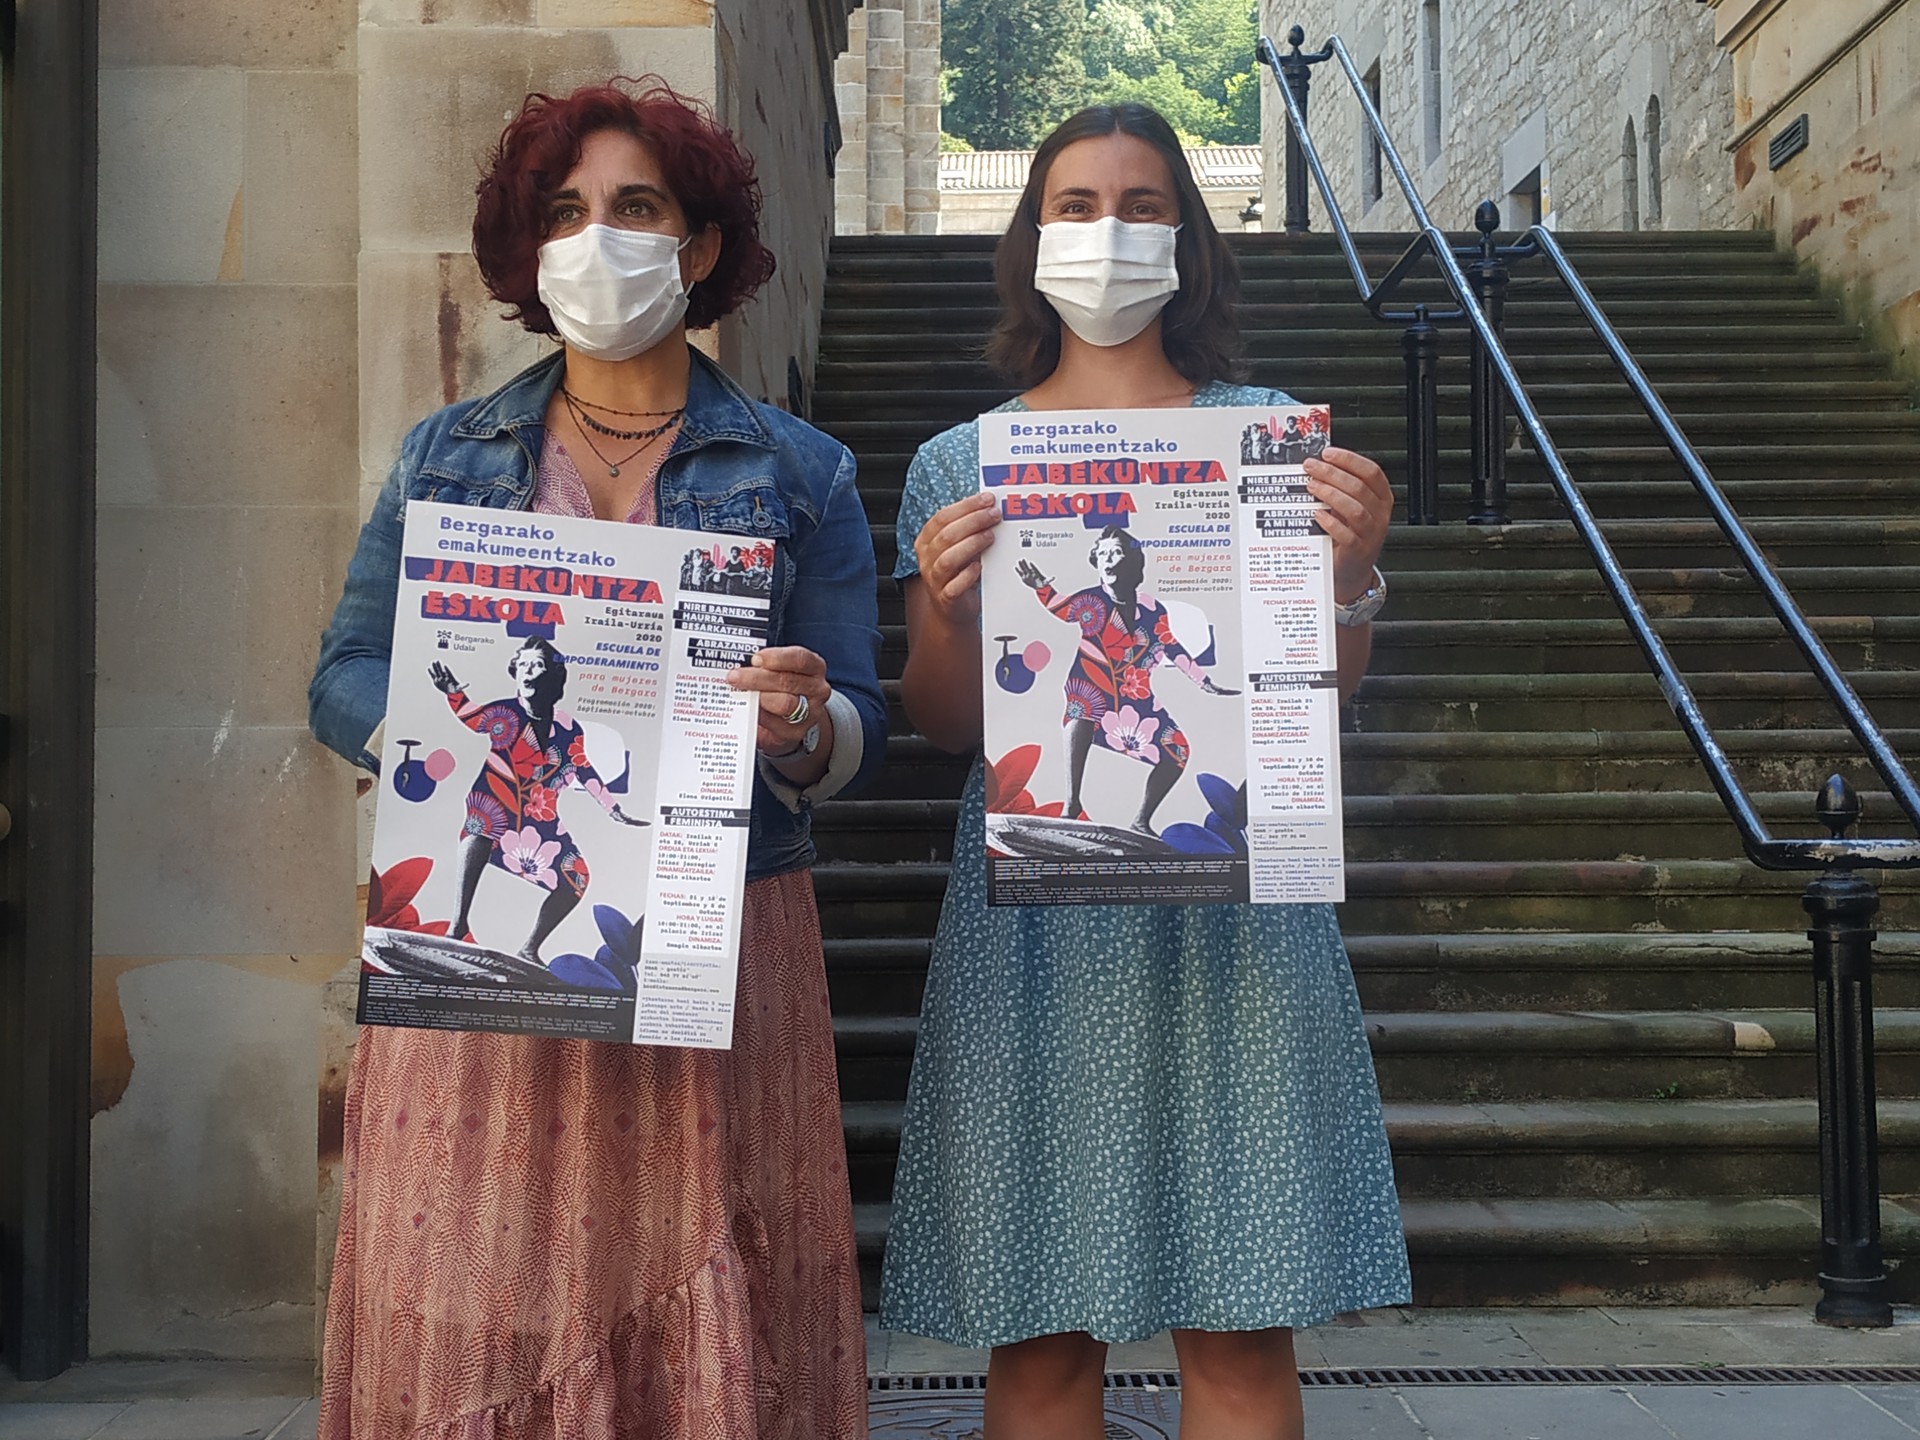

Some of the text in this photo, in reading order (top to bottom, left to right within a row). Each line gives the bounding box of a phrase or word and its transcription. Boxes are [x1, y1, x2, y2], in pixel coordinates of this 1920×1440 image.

[1010, 421, 1117, 437] Bergarako
[1010, 438, 1178, 455] emakumeentzako
[1002, 460, 1227, 484] JABEKUNTZA
[1173, 490, 1229, 499] Egitaraua
[1247, 486, 1288, 494] HAURRA
[1006, 492, 1137, 515] ESKOLA
[1155, 501, 1229, 509] Iraila-Urria
[1247, 495, 1314, 503] BESARKATZEN
[440, 516, 555, 540] Bergarako
[1169, 525, 1214, 533] ESCUELA
[437, 538, 616, 567] emakumeentzako
[1188, 554, 1231, 562] mujeres
[1188, 565, 1232, 573] Bergara
[425, 558, 664, 605] JABEKUNTZA
[425, 590, 565, 625] ESKOLA
[605, 607, 664, 619] Egitaraua
[683, 603, 755, 617] NIRE BARNEKO
[585, 616, 663, 631] Iraila-Urria
[683, 612, 725, 624] HAURRA
[682, 622, 751, 636] BESARKATZEN
[455, 634, 494, 644] Bergarako
[636, 634, 662, 642] 2020
[596, 642, 661, 656] ESCUELA DE
[696, 640, 759, 652] ABRAZANDO
[705, 650, 717, 658] MI
[579, 673, 657, 685] para mujeres
[1259, 673, 1322, 682] AUTOESTIMA
[611, 687, 657, 697] Bergara
[1260, 683, 1311, 691] FEMINISTA
[671, 808, 735, 818] AUTOESTIMA
[670, 818, 722, 827] FEMINISTA
